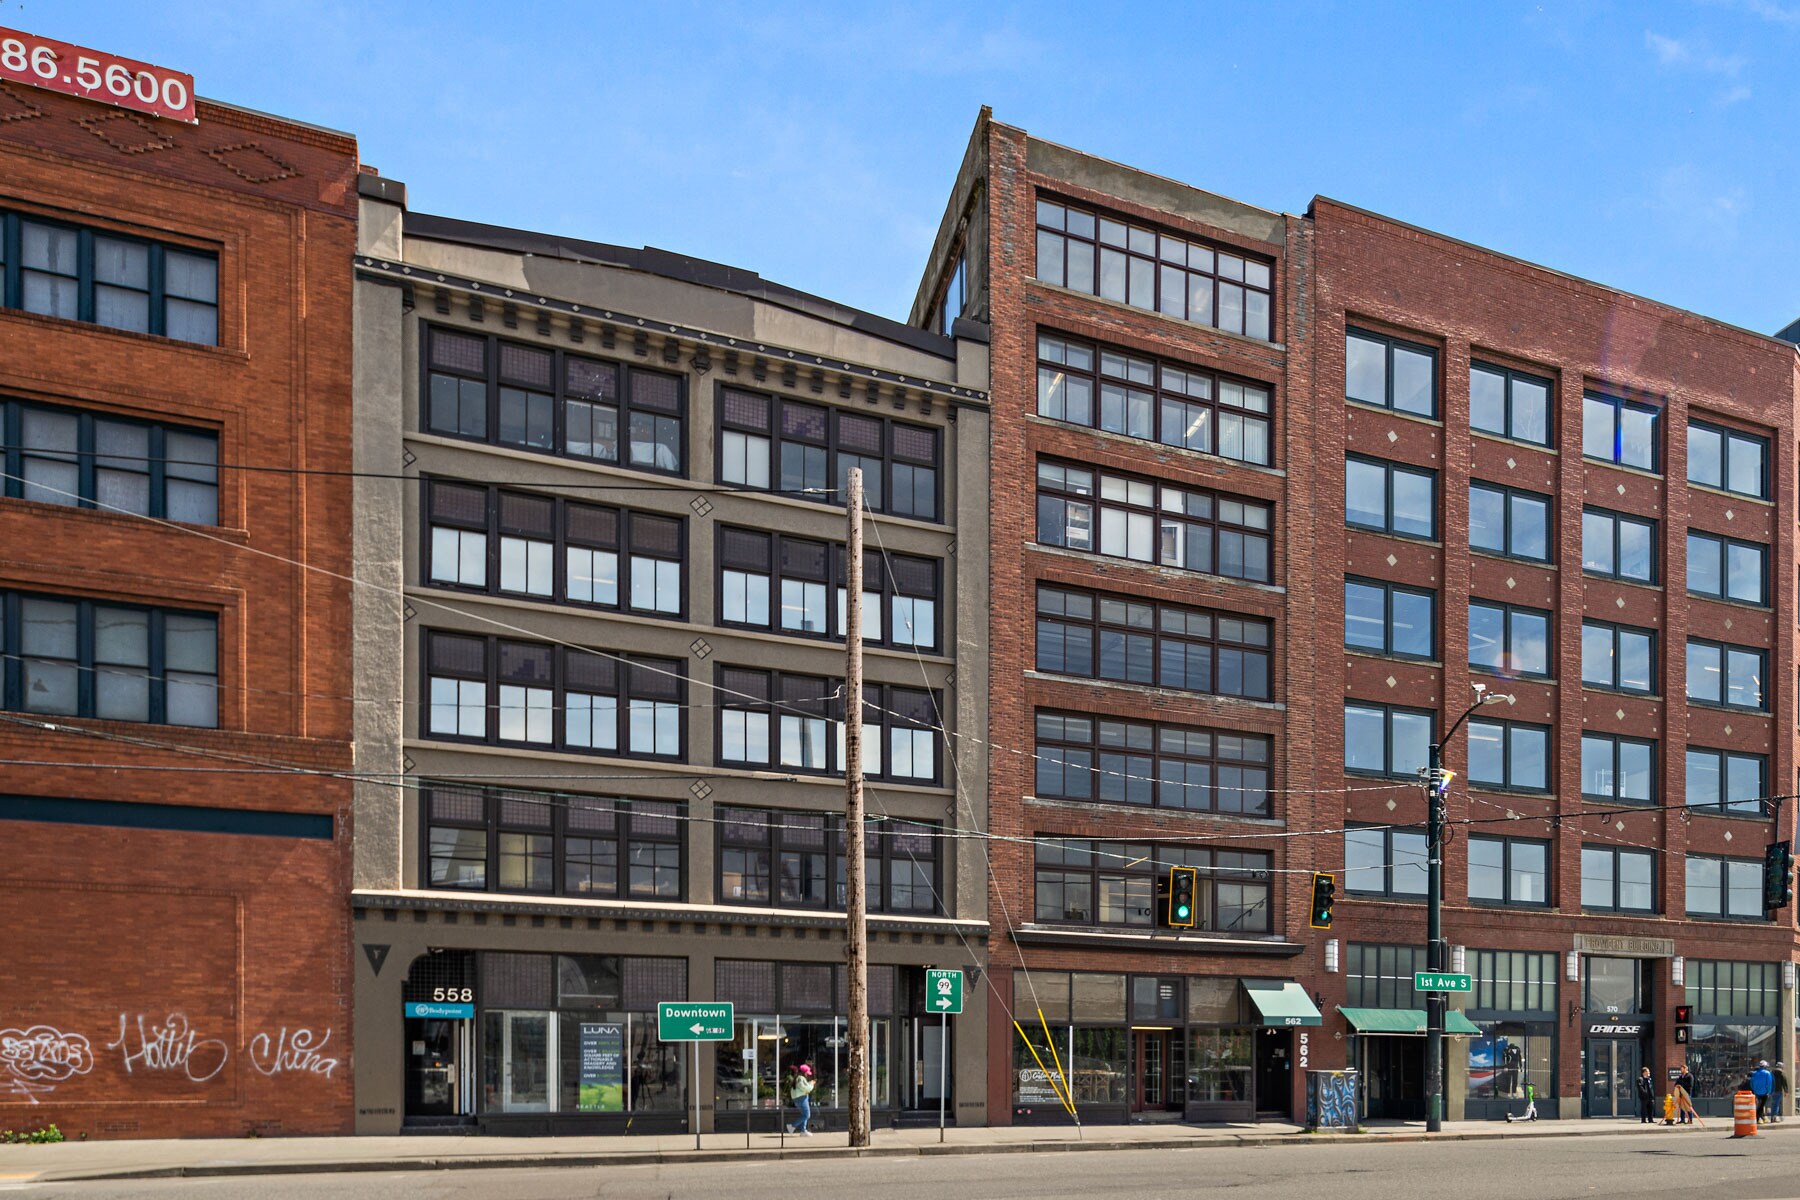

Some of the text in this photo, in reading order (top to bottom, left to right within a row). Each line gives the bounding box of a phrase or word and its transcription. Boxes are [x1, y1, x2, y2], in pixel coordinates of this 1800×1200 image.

[1, 38, 188, 111] 86.5600
[931, 971, 957, 979] NORTH
[939, 981, 950, 989] 99
[1421, 977, 1467, 988] 1st Ave S
[433, 987, 473, 1002] 558
[665, 1008, 726, 1018] Downtown
[1606, 1005, 1619, 1013] 570
[1285, 1017, 1302, 1025] 562
[1589, 1025, 1641, 1034] DAINESE
[1299, 1032, 1309, 1068] 562
